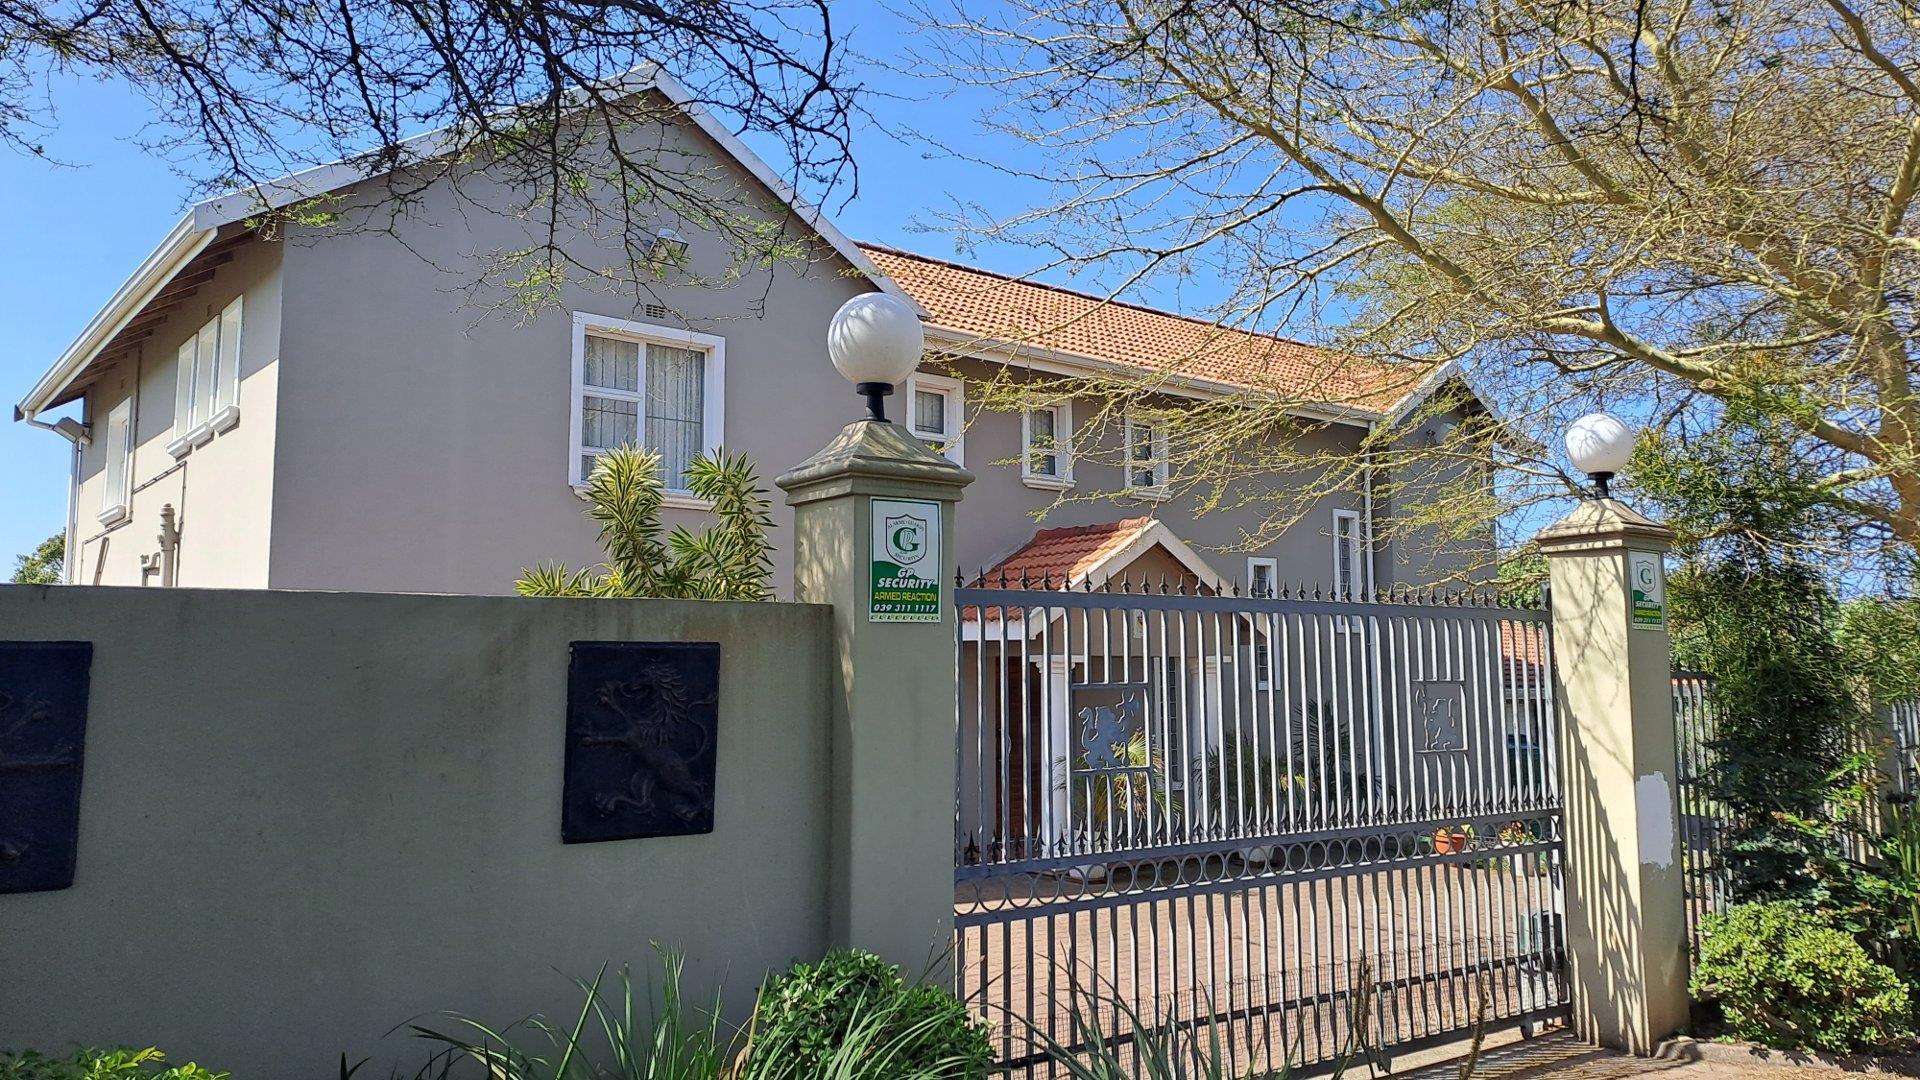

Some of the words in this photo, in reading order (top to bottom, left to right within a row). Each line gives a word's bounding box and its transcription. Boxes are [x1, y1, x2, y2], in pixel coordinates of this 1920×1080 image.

[897, 567, 915, 578] GP
[877, 577, 935, 589] SECURITY
[874, 591, 901, 601] ARMED
[902, 592, 937, 602] REACTION
[874, 603, 892, 612] 039
[895, 604, 911, 612] 311
[915, 604, 937, 613] 1117
